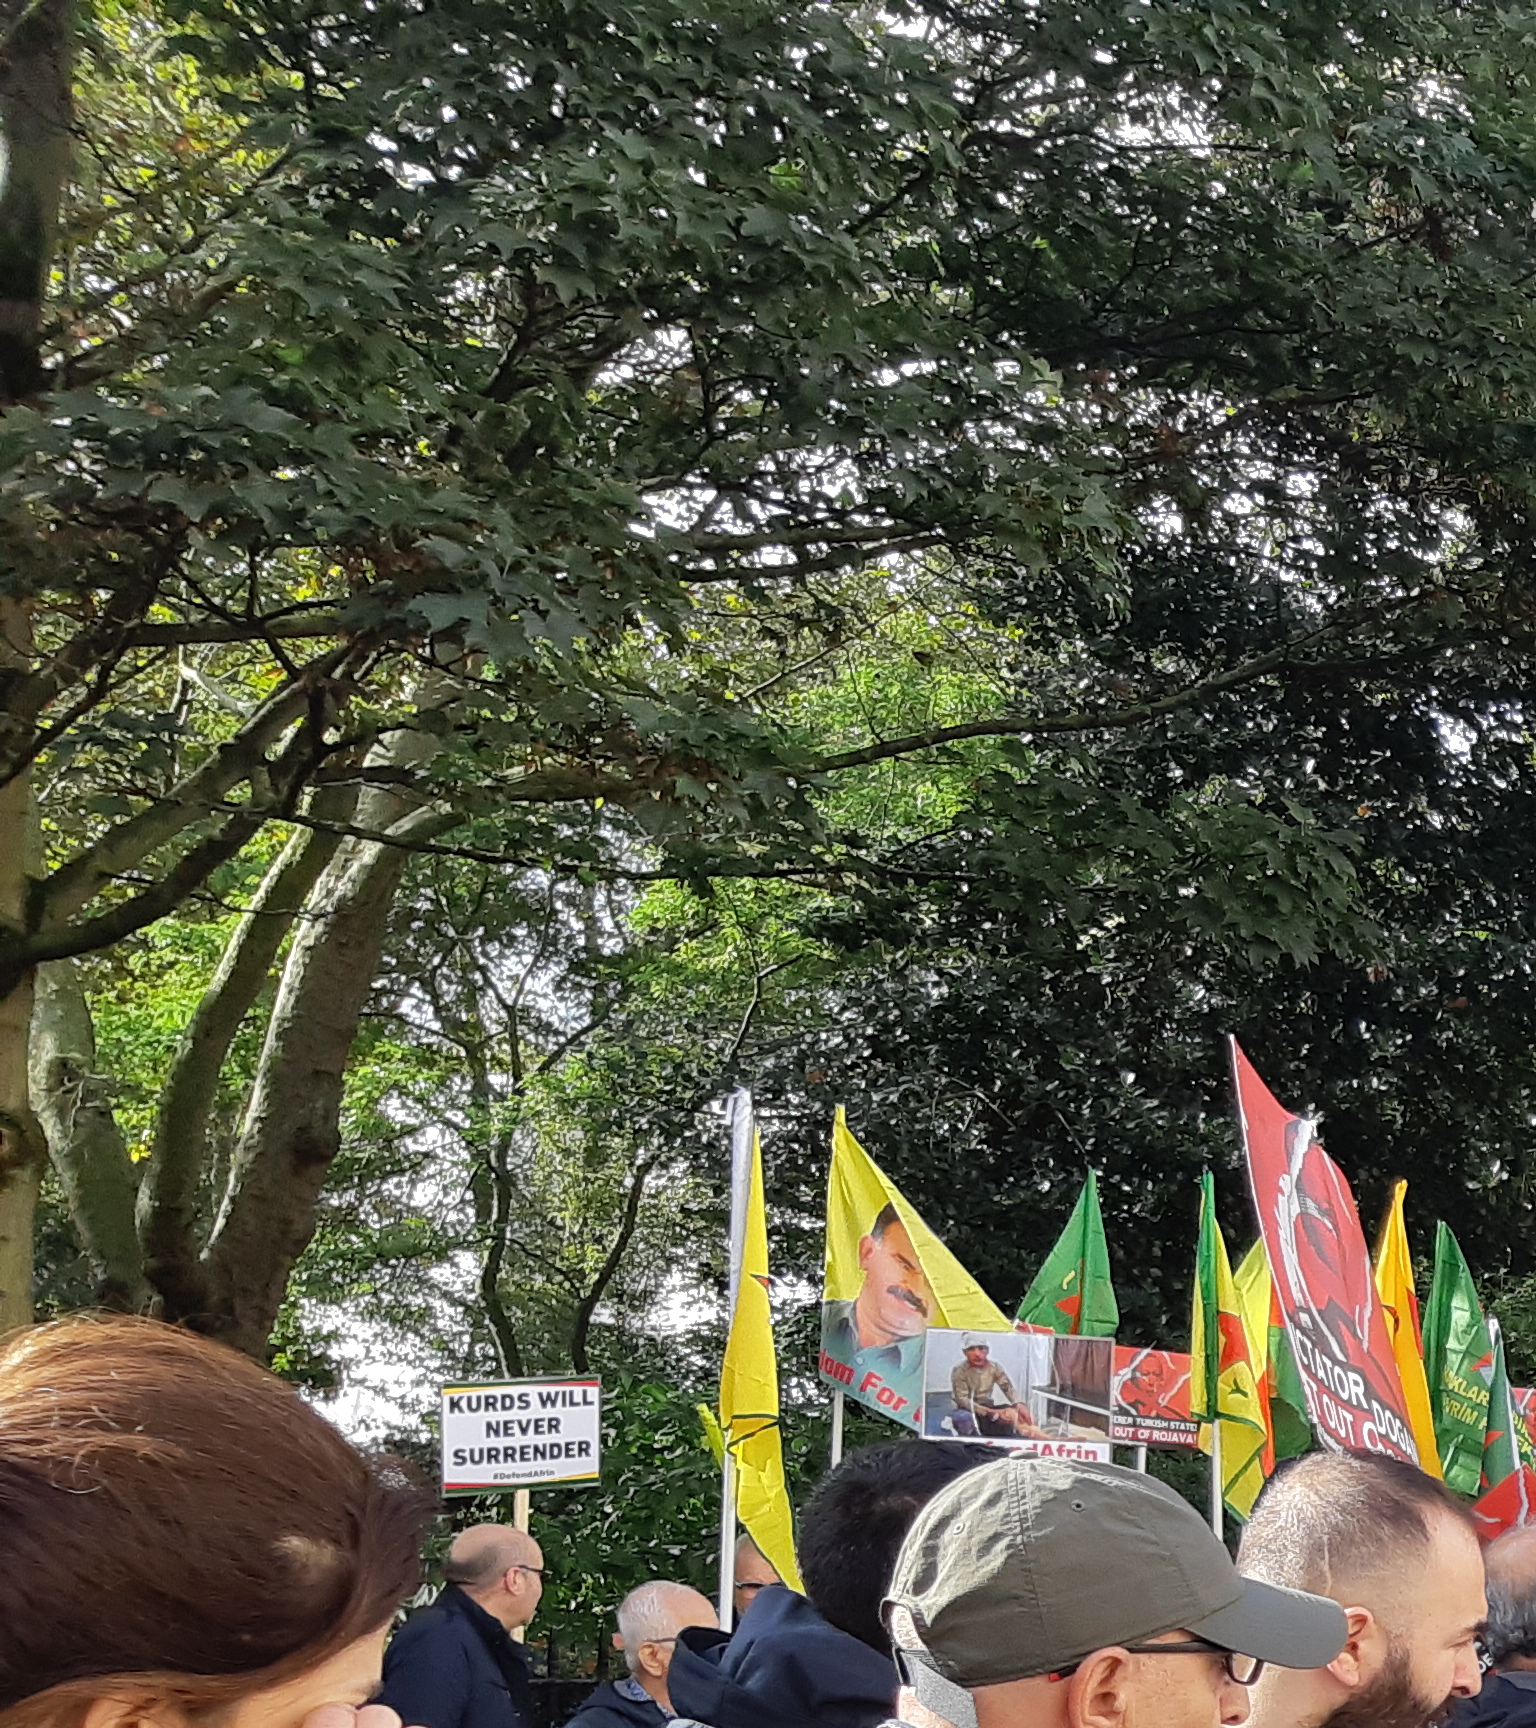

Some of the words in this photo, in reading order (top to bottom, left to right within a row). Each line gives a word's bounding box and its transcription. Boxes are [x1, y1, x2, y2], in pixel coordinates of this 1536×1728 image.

[449, 1393, 532, 1414] KURDS
[537, 1389, 595, 1409] WILL
[860, 1370, 909, 1411] For
[485, 1417, 562, 1439] NEVER
[1136, 1418, 1169, 1429] TURKISH
[1114, 1427, 1136, 1437] OUT
[1138, 1429, 1151, 1439] OF
[1153, 1431, 1198, 1445] ROJAVA!
[452, 1440, 592, 1467] SURRENDER
